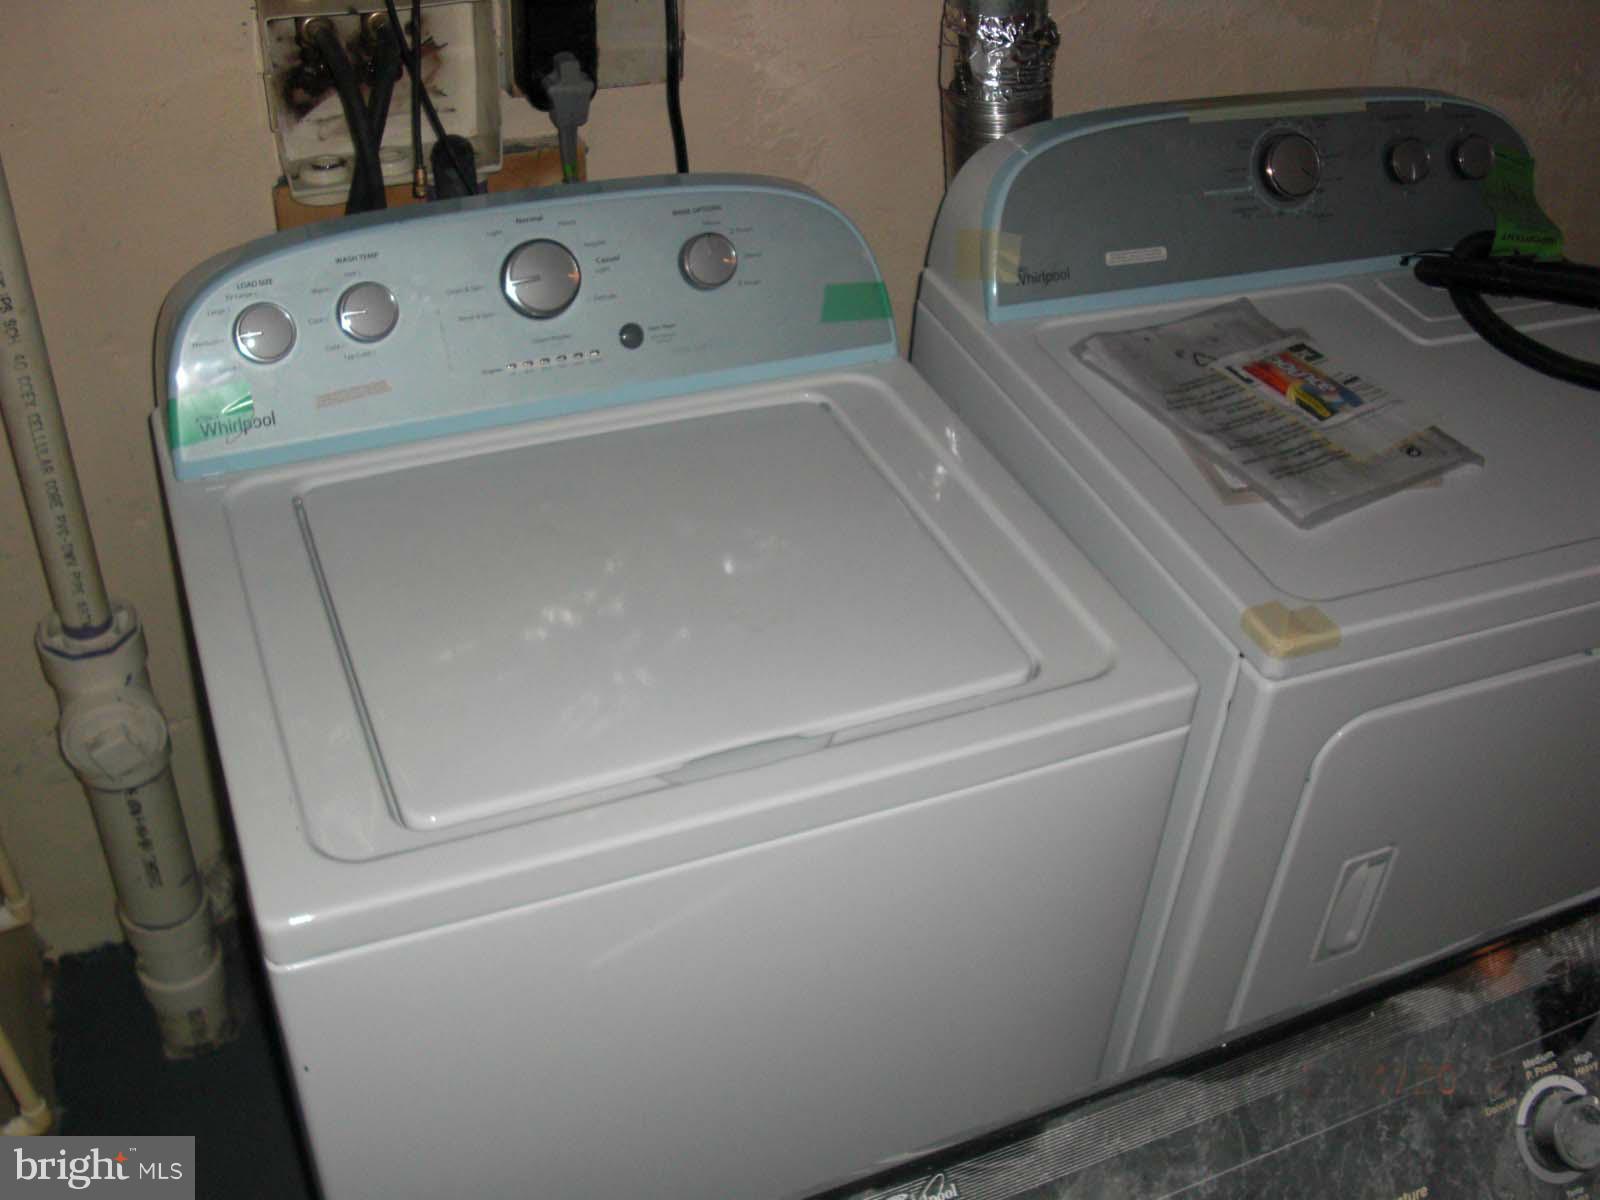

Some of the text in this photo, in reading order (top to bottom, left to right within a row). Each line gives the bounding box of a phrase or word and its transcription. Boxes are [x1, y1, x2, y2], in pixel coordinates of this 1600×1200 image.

[335, 252, 379, 264] WASH TEMP
[236, 280, 257, 290] LOAD
[199, 408, 277, 438] Whirlpool
